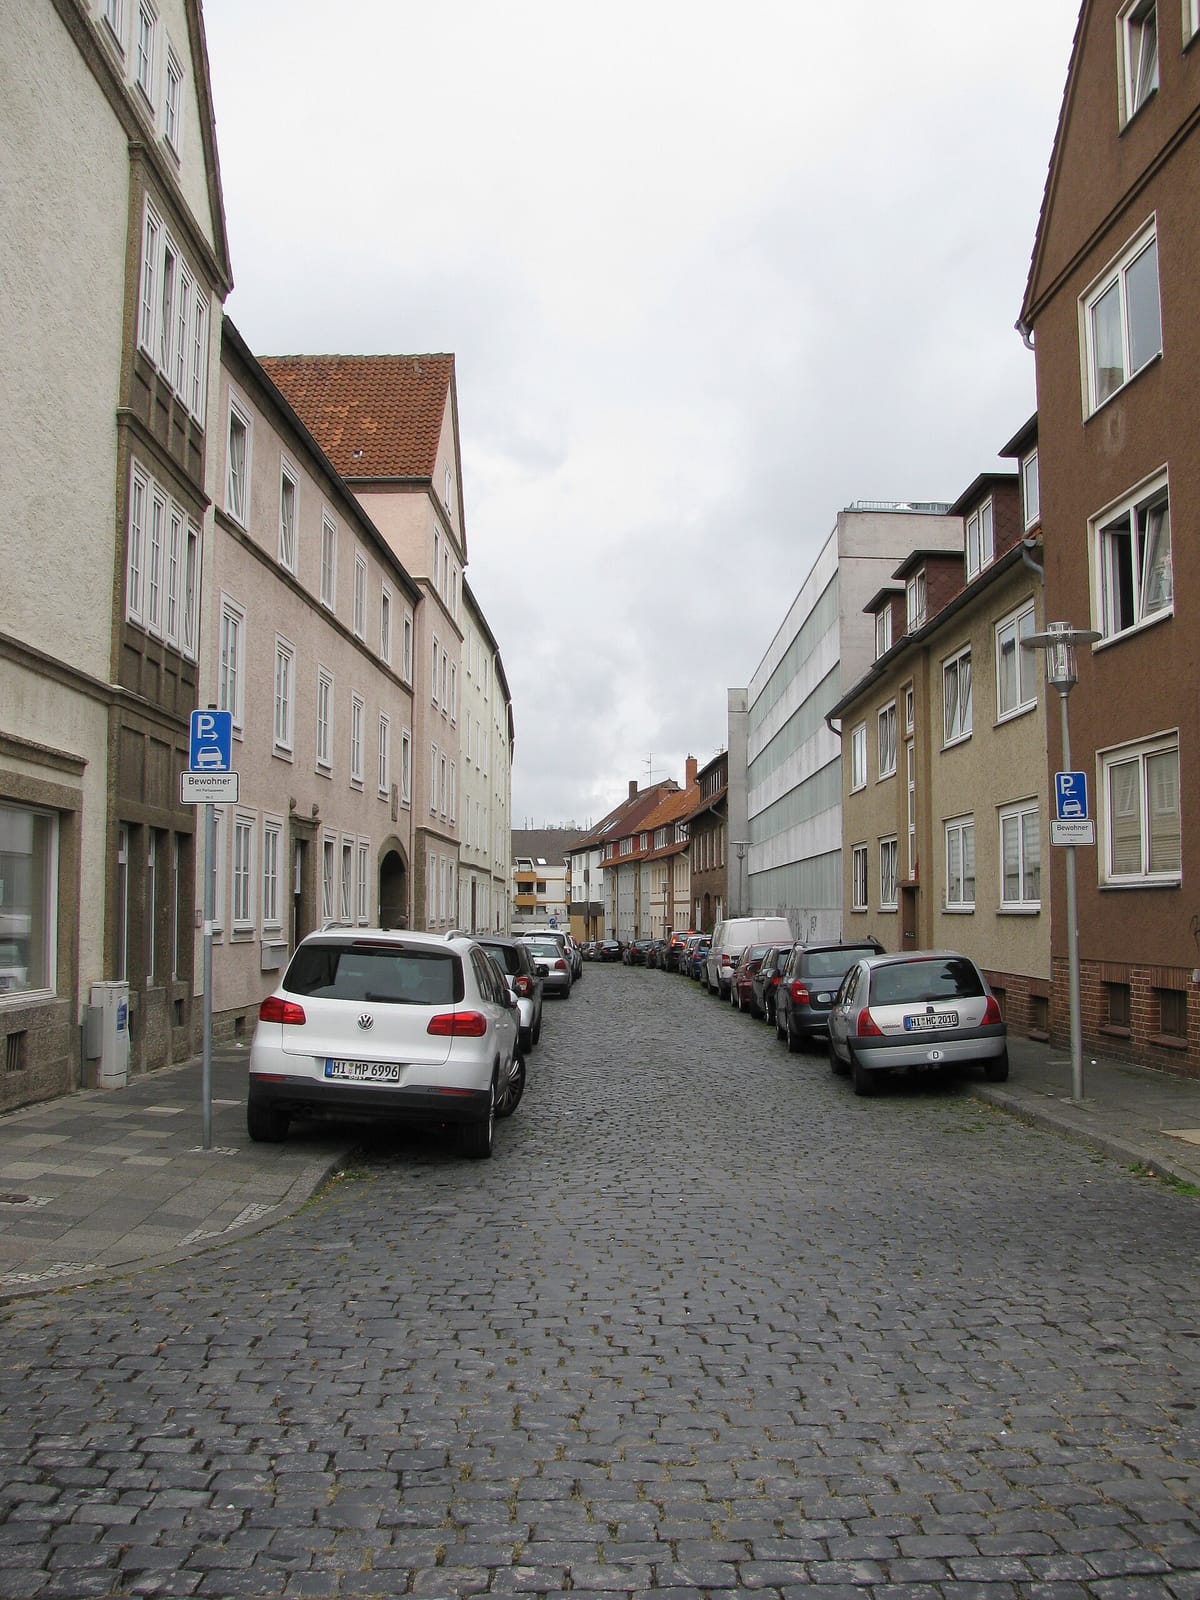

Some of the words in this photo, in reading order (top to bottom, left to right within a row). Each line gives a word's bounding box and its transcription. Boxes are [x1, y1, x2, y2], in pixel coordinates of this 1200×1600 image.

[197, 715, 215, 739] P
[188, 776, 231, 785] Bewohner
[1060, 776, 1074, 794] P
[911, 1018, 920, 1026] HI
[938, 1015, 956, 1024] 2010
[932, 1051, 939, 1059] D
[333, 1062, 346, 1073] HI
[354, 1063, 369, 1075] MP
[371, 1065, 397, 1077] 6996
